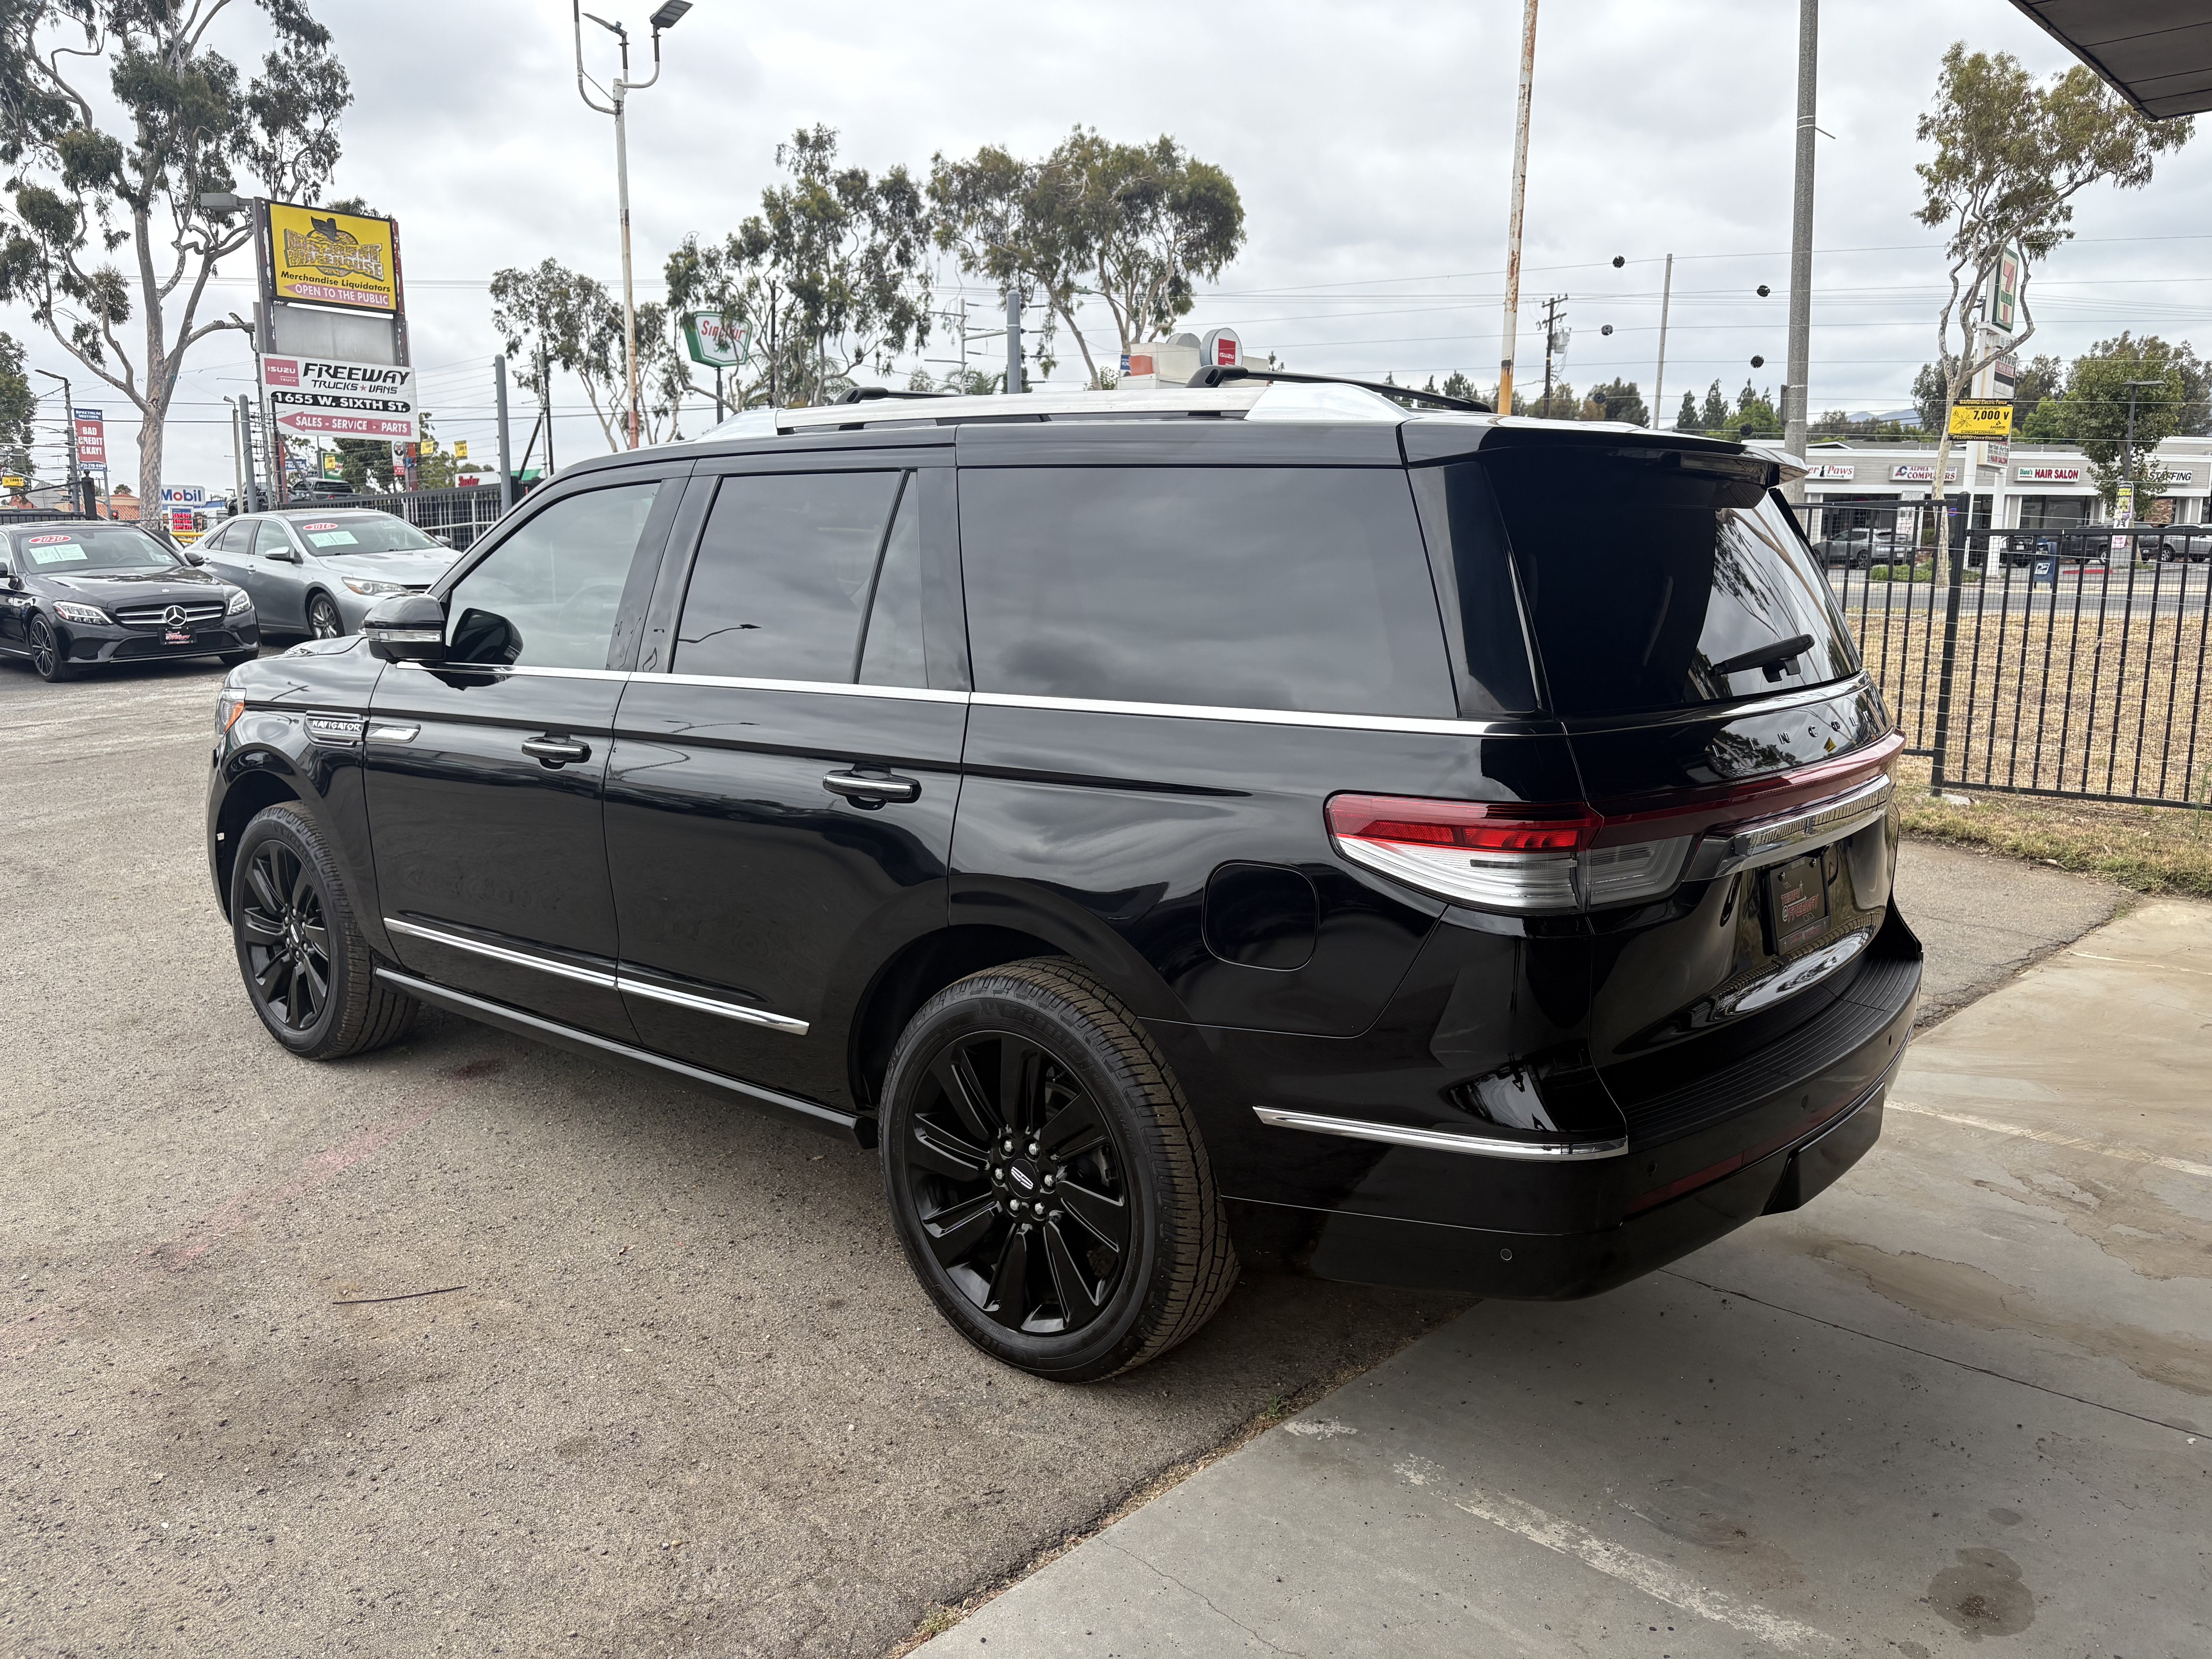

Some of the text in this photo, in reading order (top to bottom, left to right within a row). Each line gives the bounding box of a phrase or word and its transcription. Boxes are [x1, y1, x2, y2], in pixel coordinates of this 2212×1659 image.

[281, 271, 390, 292] Merchandise Liquidators
[295, 284, 388, 305] OPEN TO THE PUBLIC
[303, 362, 411, 386] FREEWAY
[311, 380, 398, 394] TRUCKS VANS
[276, 392, 406, 412] 1655 W. SIXTH ST.
[1973, 410, 2009, 421] 7,000 V
[82, 426, 97, 435] BAD
[295, 416, 322, 427] SALES
[332, 420, 368, 431] SERVICE
[381, 422, 407, 433] PARTS
[78, 436, 103, 445] CREDIT
[1827, 465, 1853, 475] Paws
[2035, 469, 2052, 479] HAIR
[2054, 469, 2078, 479] SALON
[2149, 472, 2192, 481] STFING
[161, 488, 201, 502] Mobil
[312, 720, 361, 732] NAVIGATOR
[1712, 710, 1869, 757] LINCOLN
